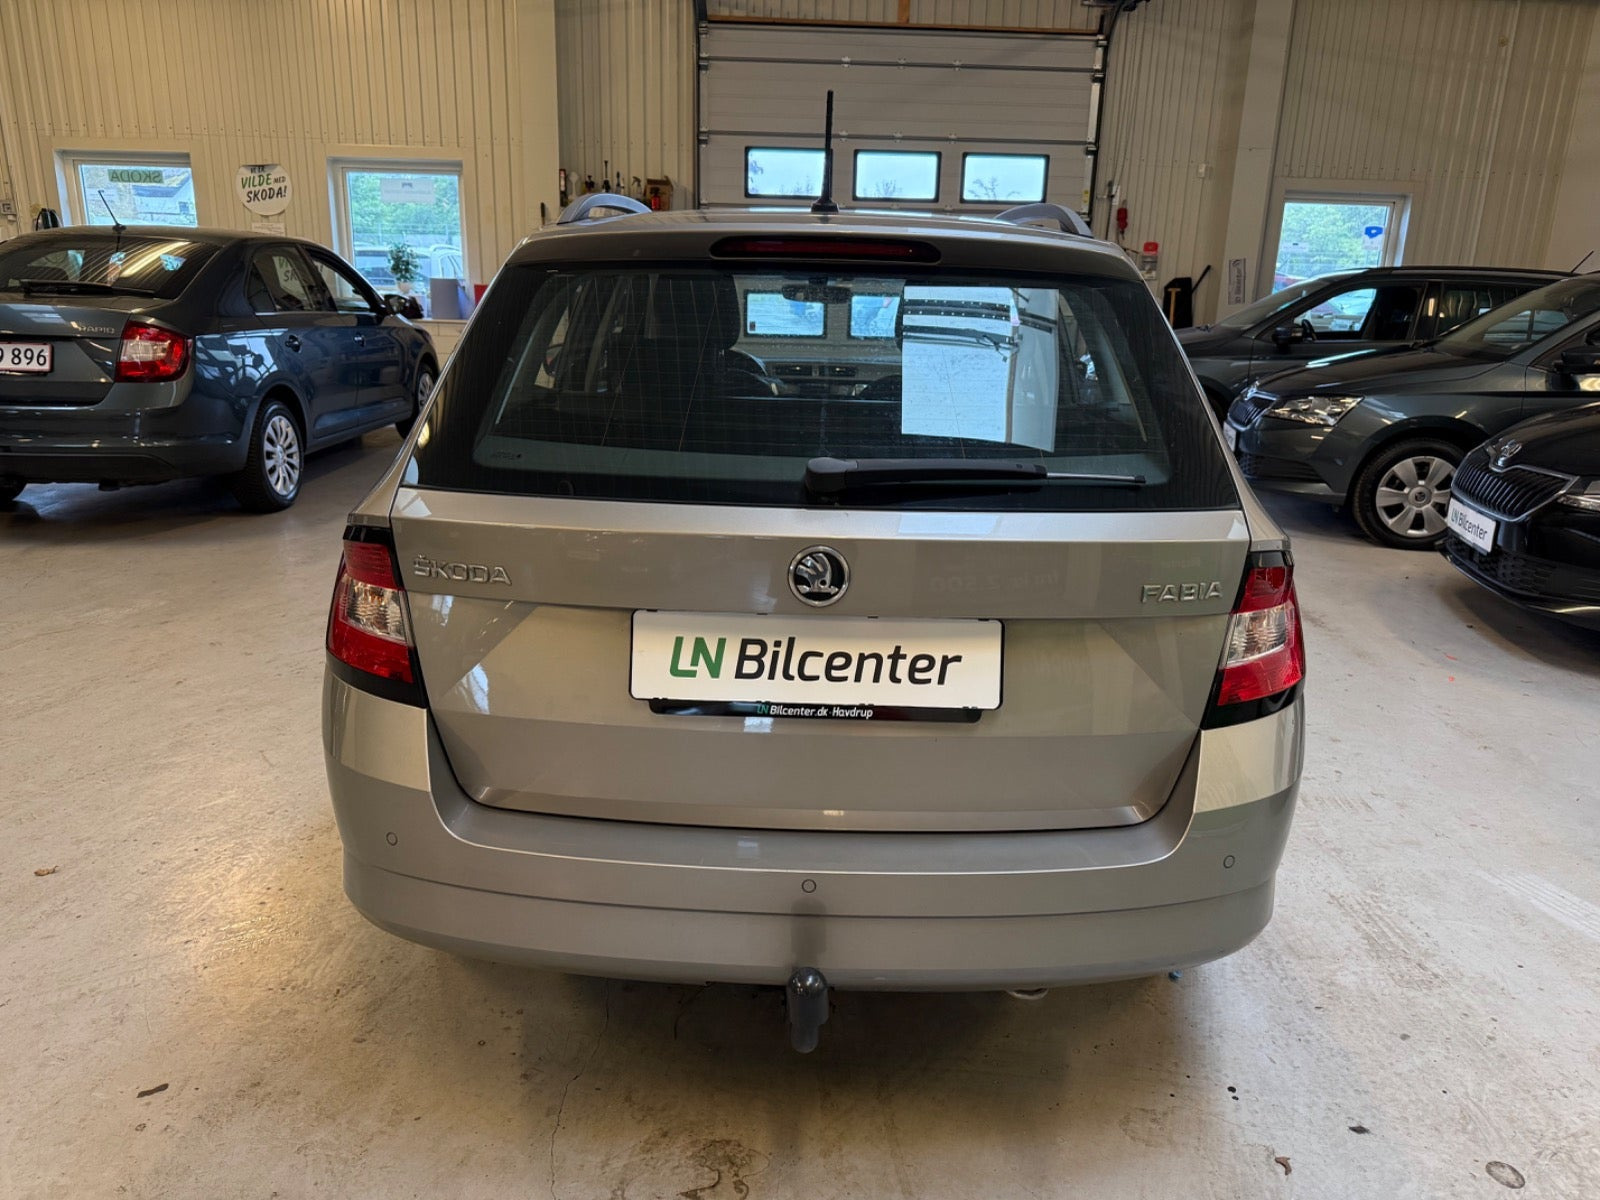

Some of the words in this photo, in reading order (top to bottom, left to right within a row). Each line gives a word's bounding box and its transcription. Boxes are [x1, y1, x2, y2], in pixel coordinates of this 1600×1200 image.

[241, 173, 272, 189] VILDE
[246, 185, 287, 203] SKODA!
[11, 347, 47, 366] 896
[1140, 581, 1222, 604] FABIA
[669, 636, 727, 679] LN
[734, 636, 963, 686] Bilcenter
[757, 705, 769, 714] LN
[831, 706, 874, 719] Havdrup
